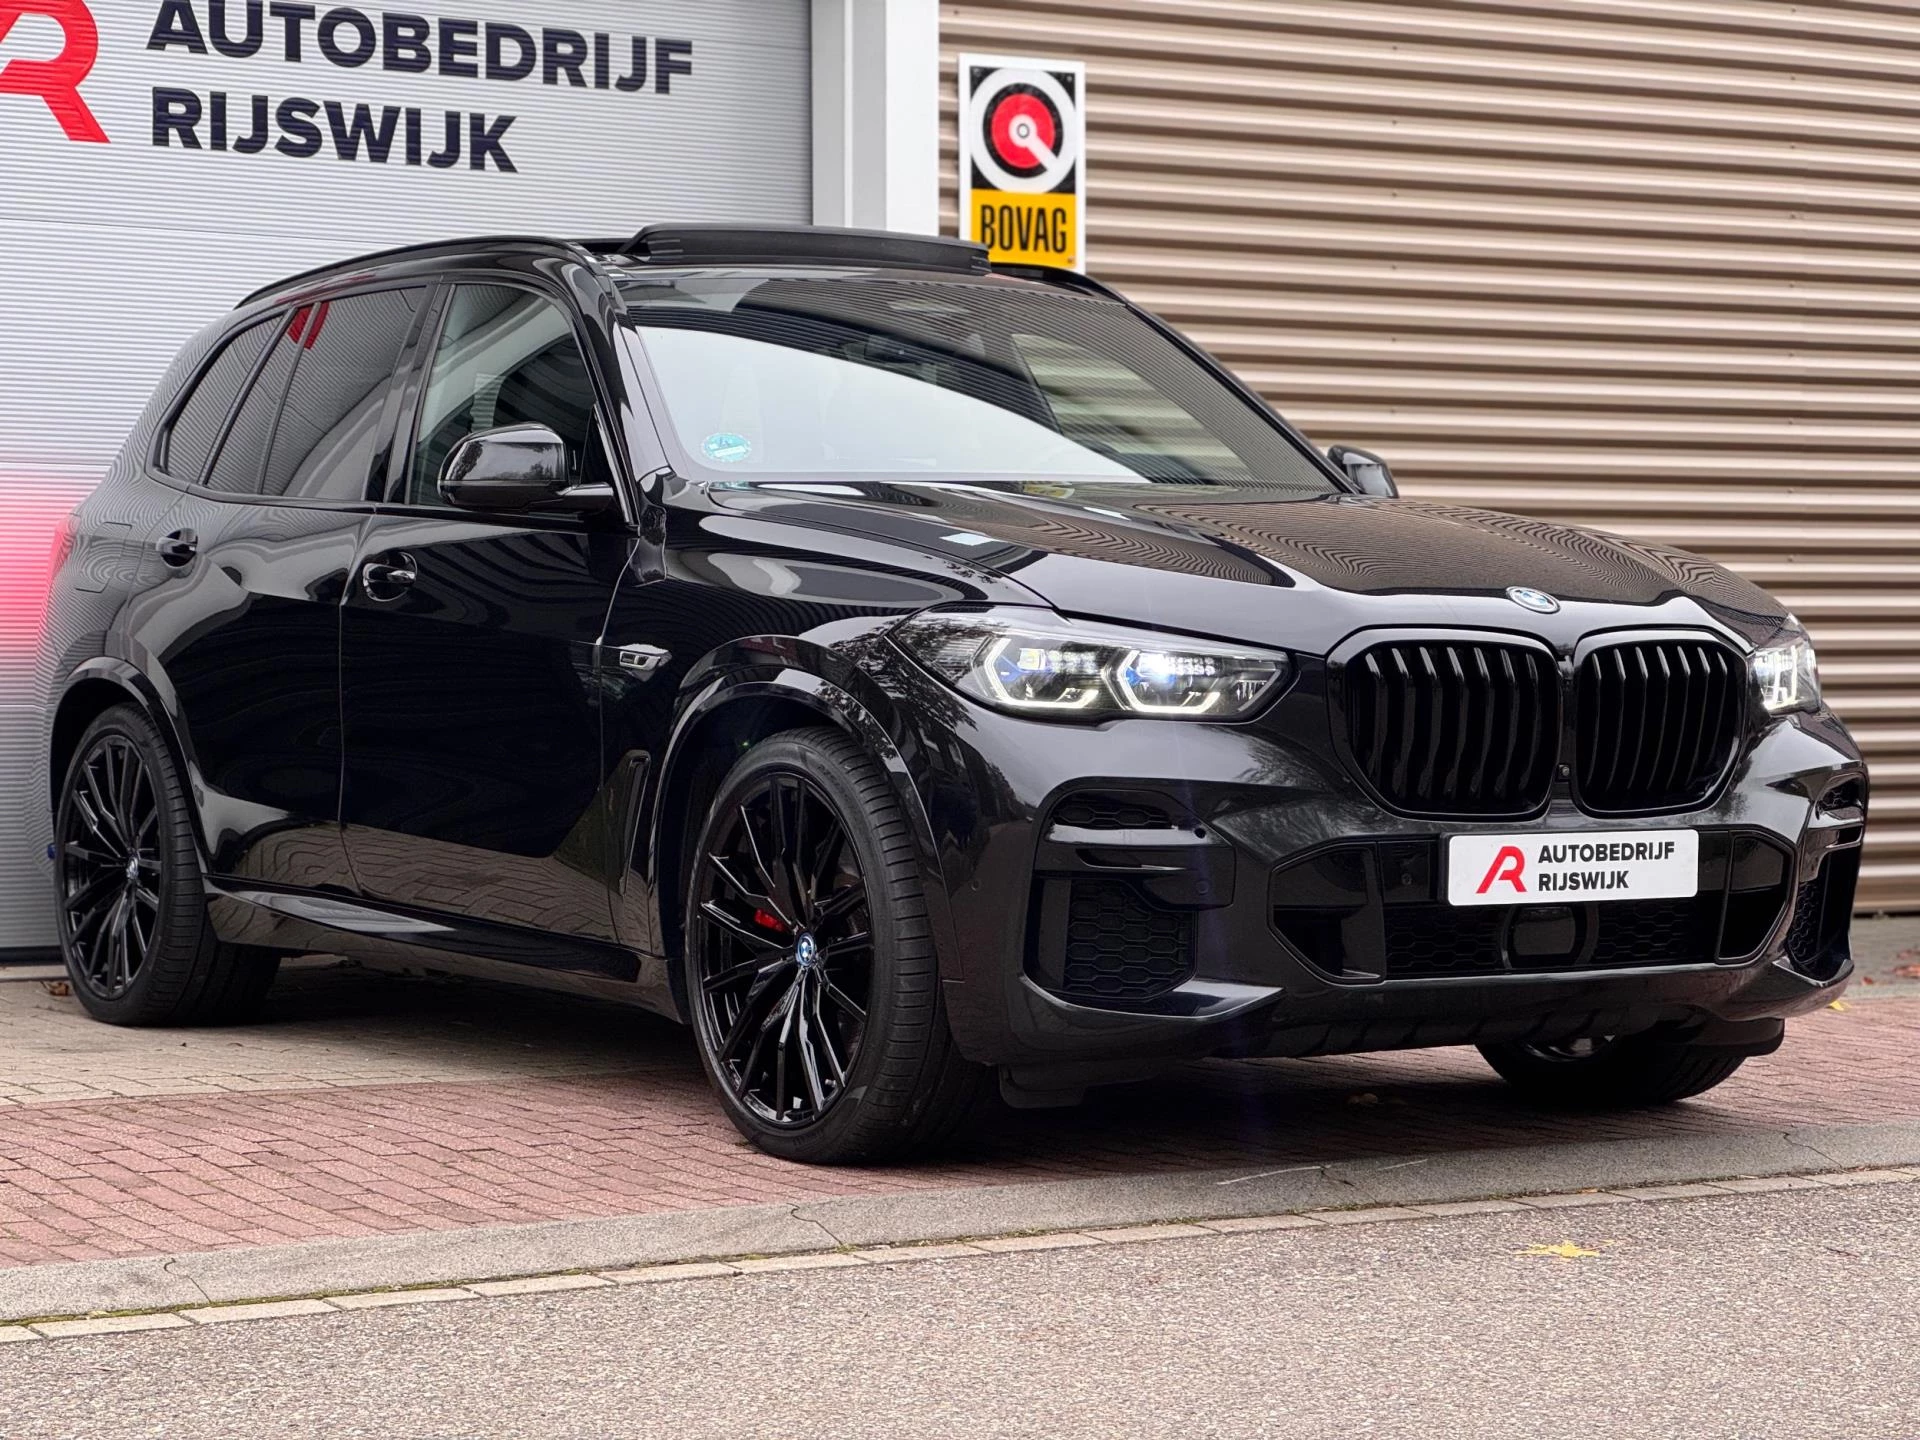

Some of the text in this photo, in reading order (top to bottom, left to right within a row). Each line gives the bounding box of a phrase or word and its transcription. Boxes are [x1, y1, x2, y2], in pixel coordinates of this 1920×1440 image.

[146, 0, 693, 95] AUTOBEDRIJF
[152, 86, 518, 173] RIJSWIJK
[980, 204, 1067, 253] BOVAG
[1538, 841, 1675, 864] AUTOBEDRIJF
[1538, 870, 1629, 892] RIJSWIJK
